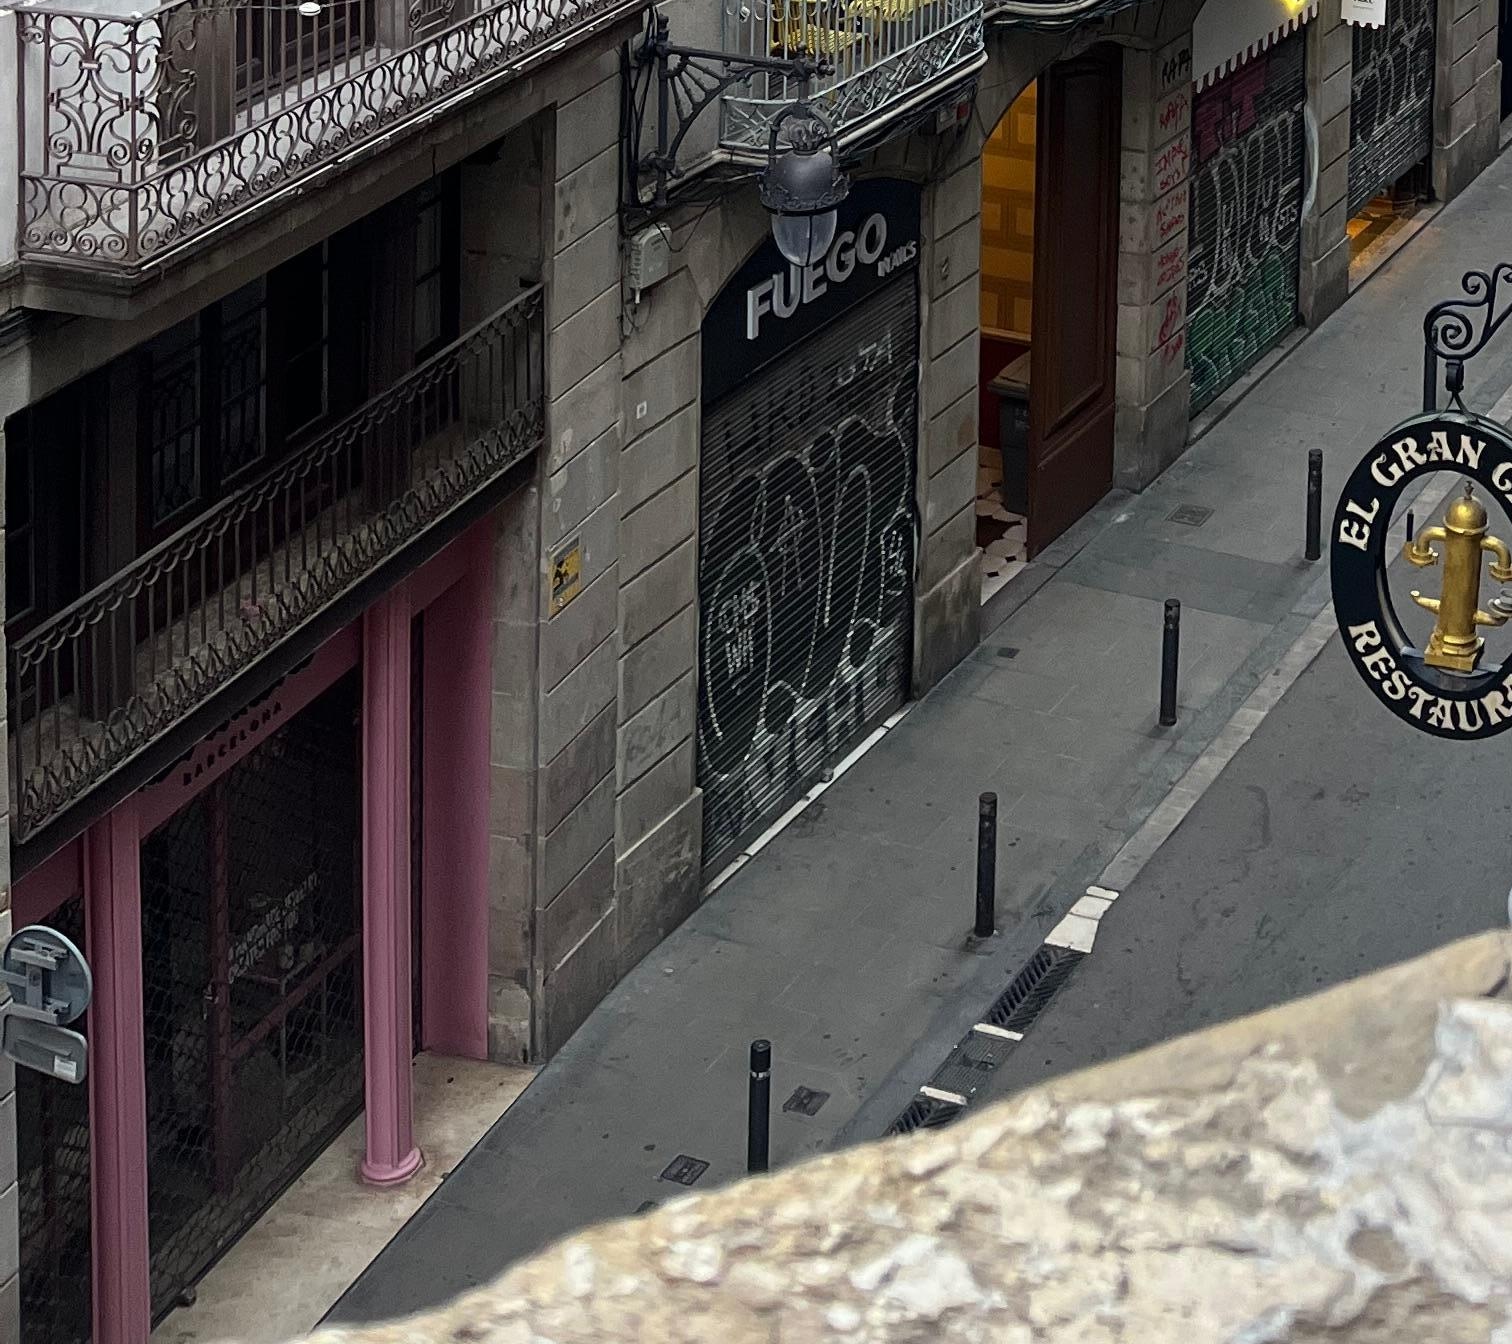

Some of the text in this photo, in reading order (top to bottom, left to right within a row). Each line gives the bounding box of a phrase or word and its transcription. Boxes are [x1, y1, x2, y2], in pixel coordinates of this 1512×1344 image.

[747, 213, 887, 340] FUEGO
[1339, 496, 1380, 551] EL
[1370, 431, 1487, 488] GRAN
[183, 701, 282, 786] BARCELONA
